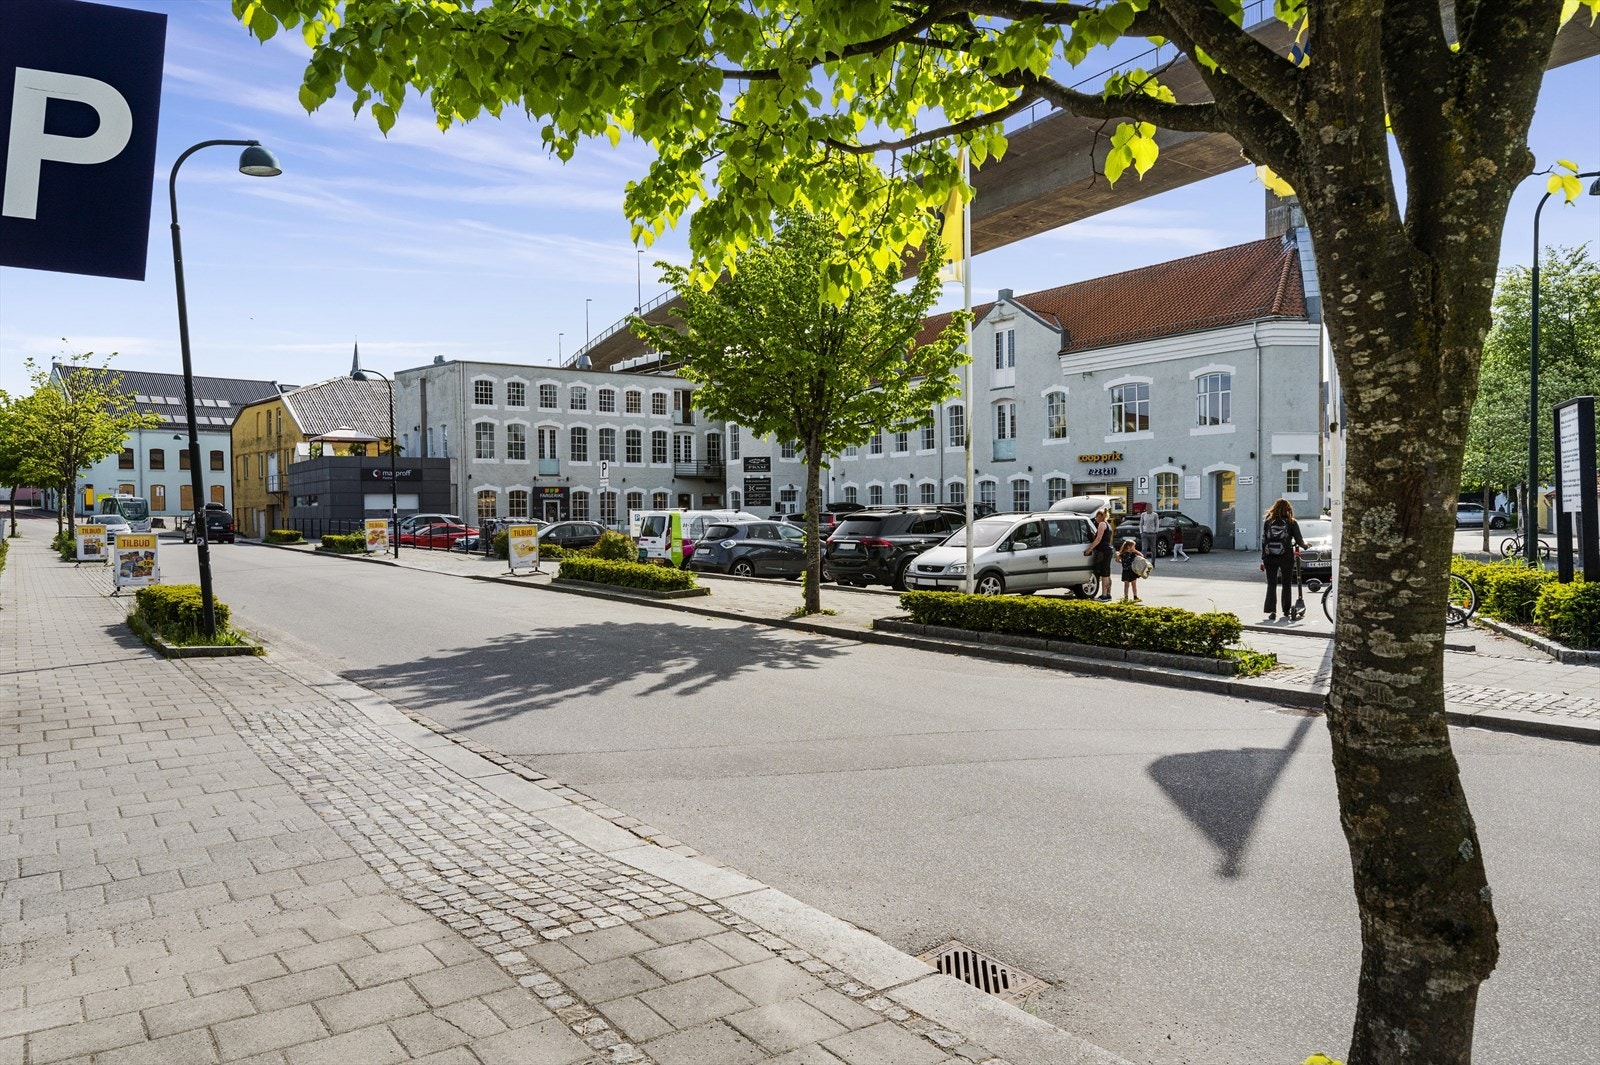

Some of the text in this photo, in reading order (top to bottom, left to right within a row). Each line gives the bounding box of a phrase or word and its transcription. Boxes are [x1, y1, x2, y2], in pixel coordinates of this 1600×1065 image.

[2, 66, 133, 220] P
[1079, 451, 1123, 463] coop prix
[382, 469, 412, 477] maproff
[602, 462, 608, 477] P
[1140, 478, 1146, 487] P
[513, 529, 533, 537] TILBUD
[122, 539, 150, 547] TILBUD
